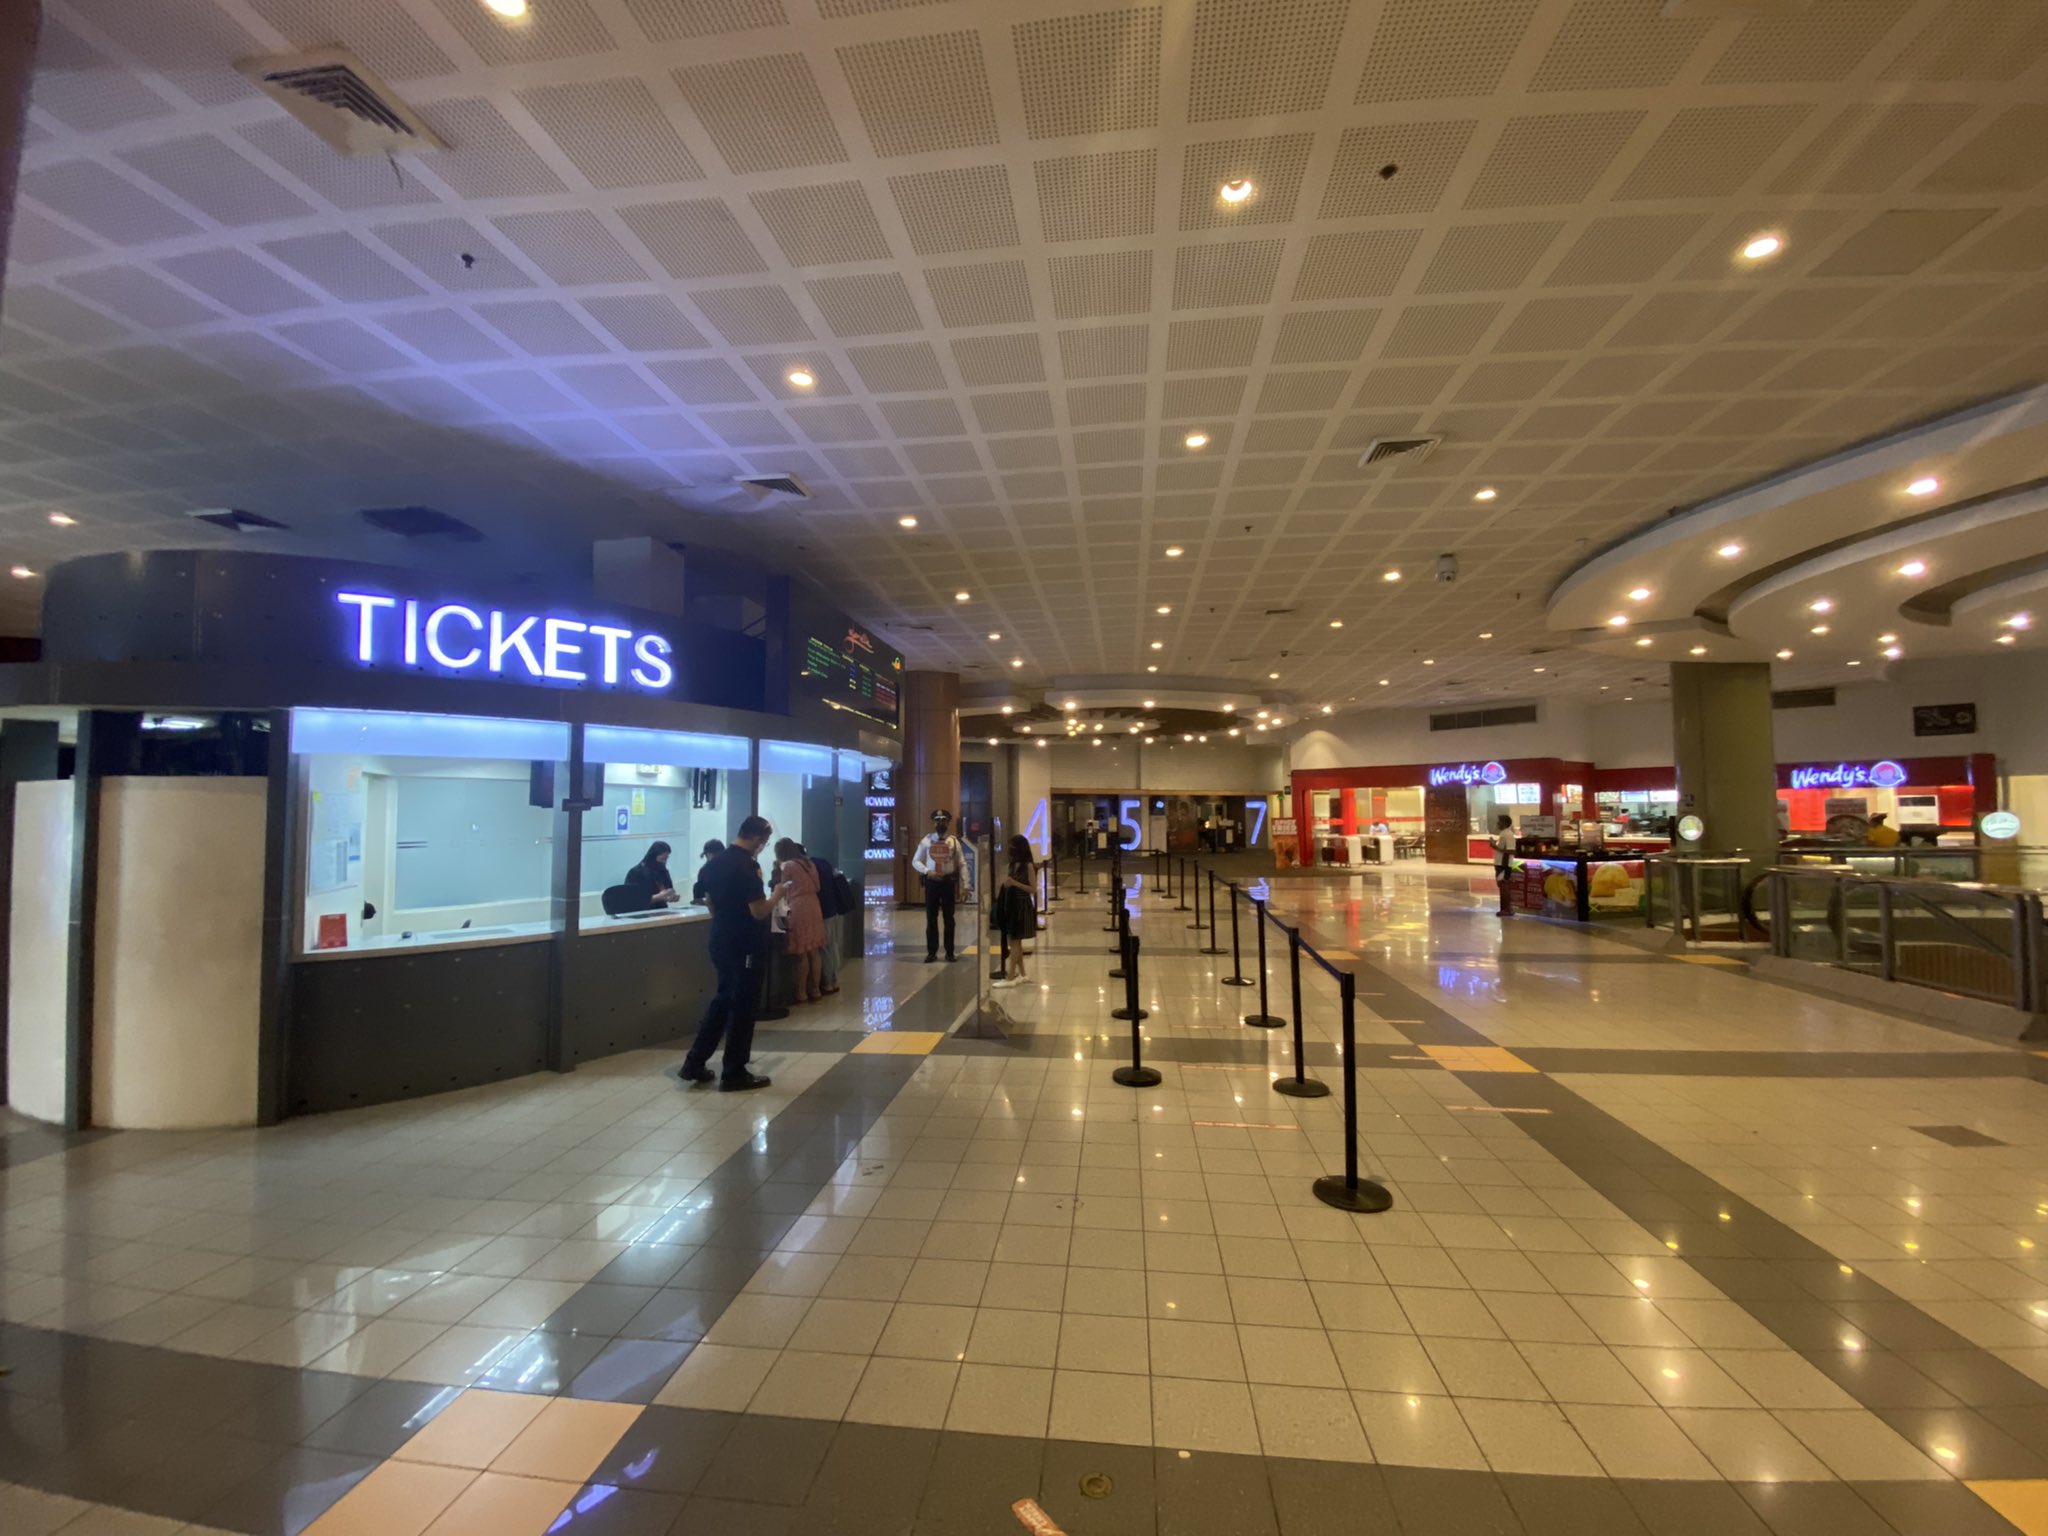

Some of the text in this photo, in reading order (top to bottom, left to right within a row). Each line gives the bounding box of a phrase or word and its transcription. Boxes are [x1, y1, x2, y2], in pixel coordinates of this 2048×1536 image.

[336, 591, 673, 689] TICKETS
[1429, 764, 1480, 786] Wendy's
[1791, 763, 1867, 789] Wendy's
[1023, 798, 1050, 857] 4
[1120, 800, 1141, 850] 5
[1246, 801, 1267, 845] 7
